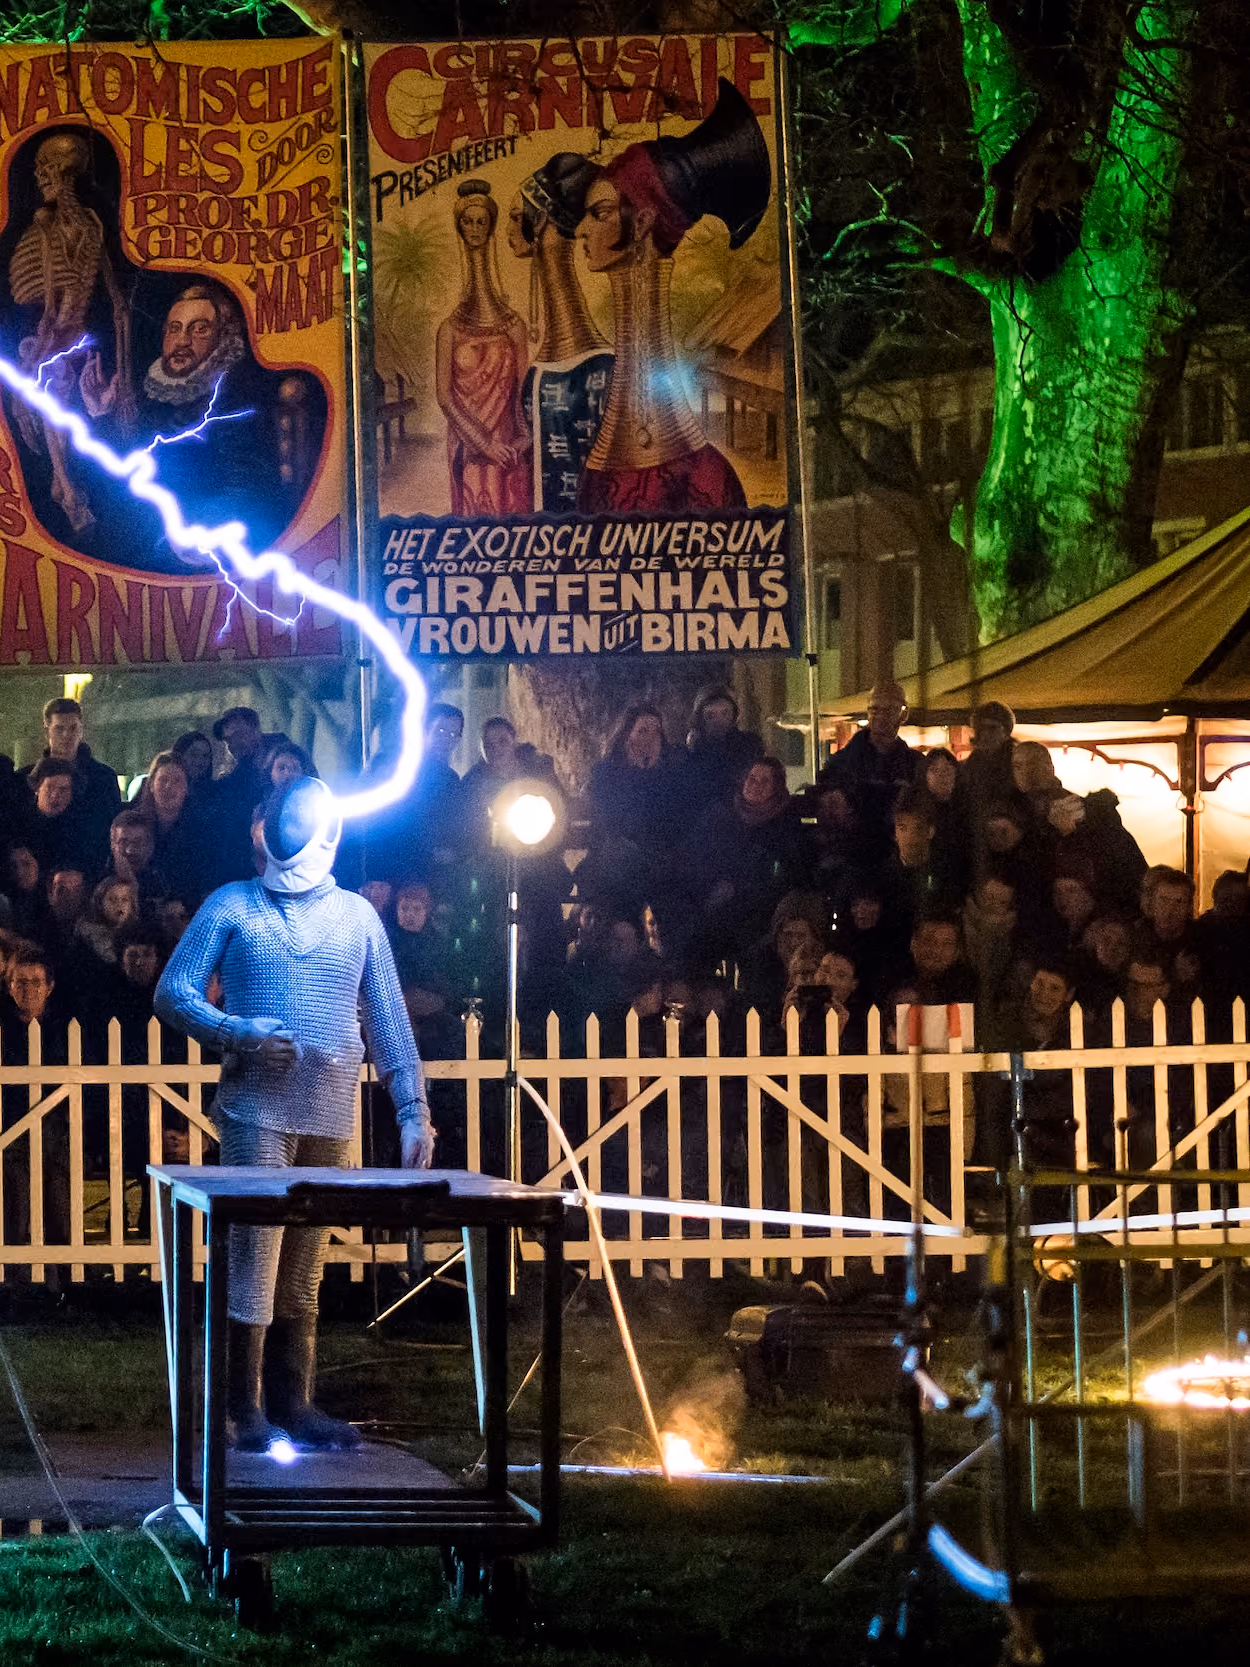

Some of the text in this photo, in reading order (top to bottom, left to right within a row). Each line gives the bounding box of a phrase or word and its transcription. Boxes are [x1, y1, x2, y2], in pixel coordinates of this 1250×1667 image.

[432, 37, 661, 78] CIRCUS
[127, 117, 244, 196] LES
[255, 105, 340, 191] DOOR
[135, 217, 336, 266] GEORGE
[254, 247, 340, 335] MAAT
[383, 519, 786, 561] HET EXOTISCH UNIVERSUM
[384, 553, 785, 576] DE WONDEREN VAN DE WERELD
[384, 569, 789, 614] GIRAFFENHALS
[386, 611, 791, 655] VROUWEN UIT BIRMA
